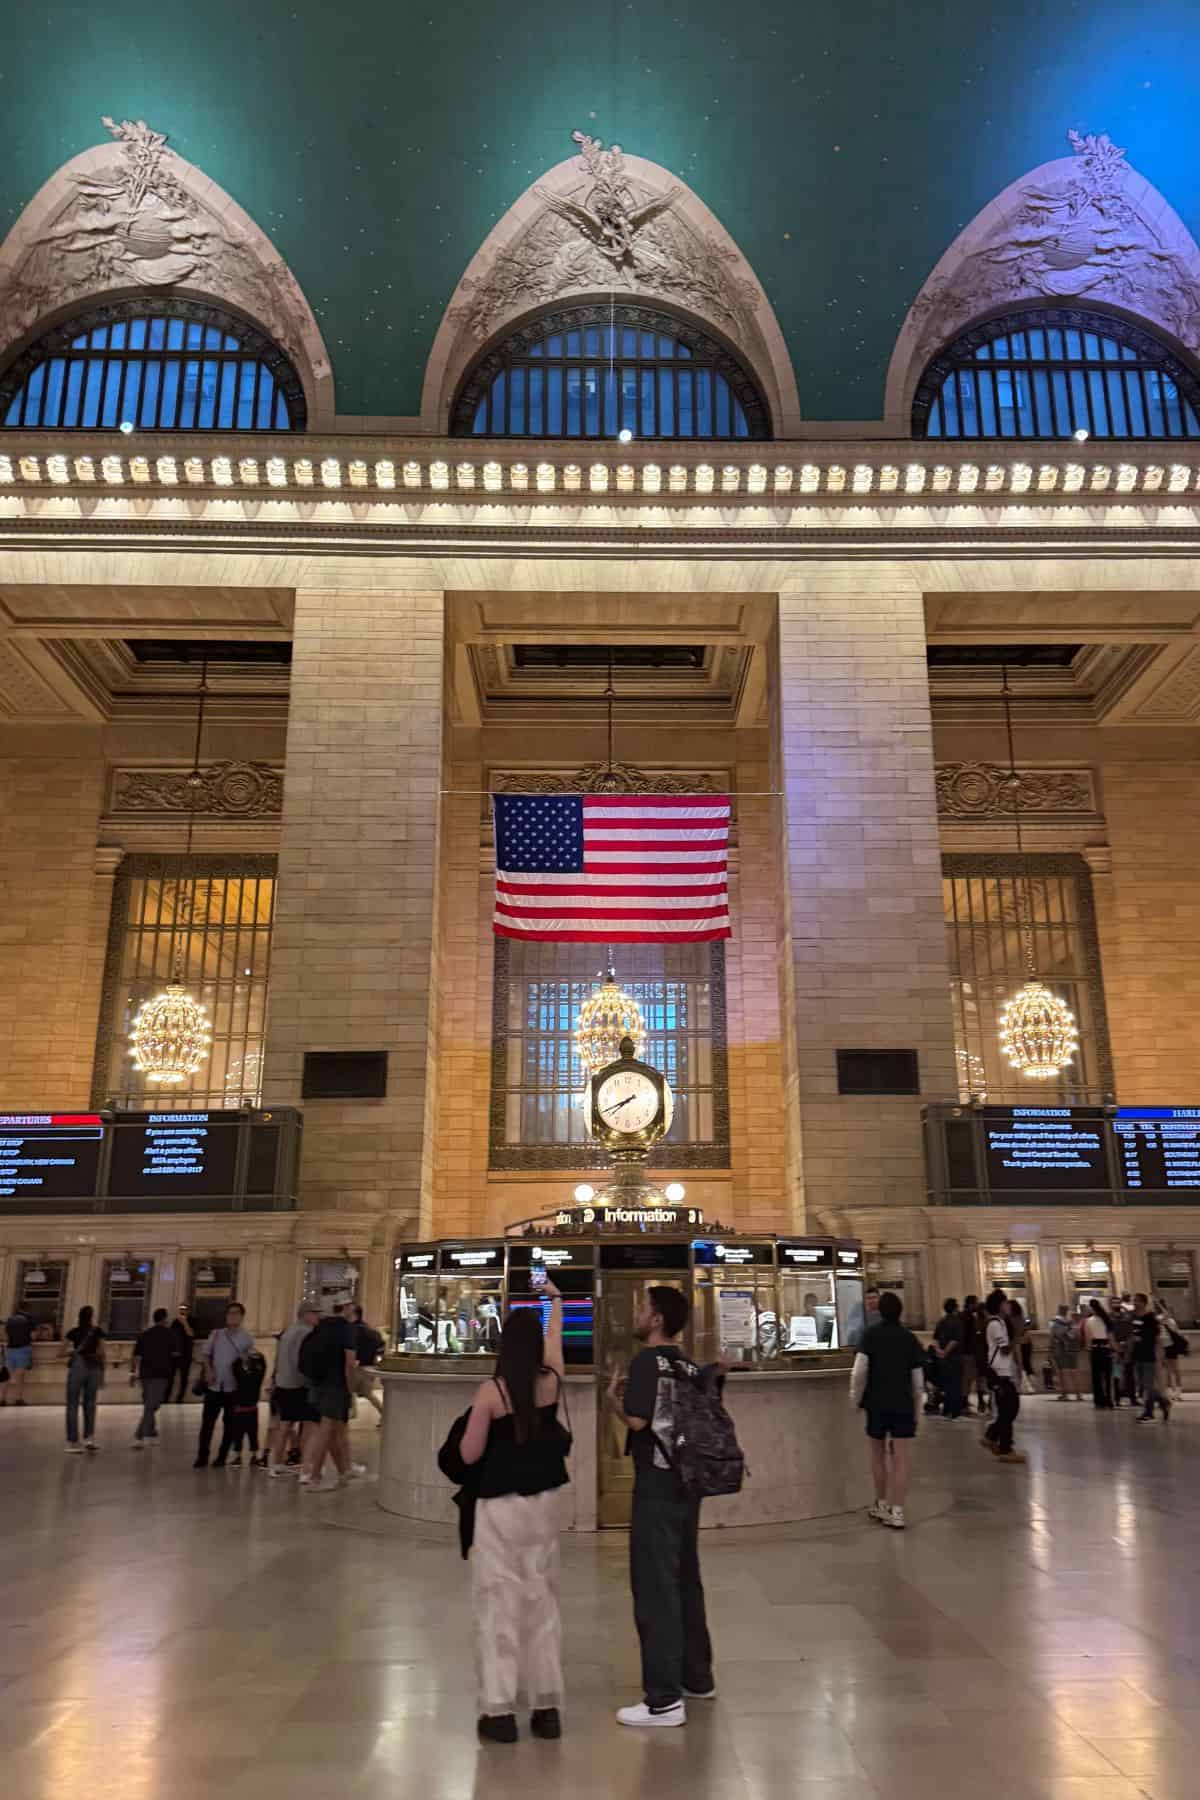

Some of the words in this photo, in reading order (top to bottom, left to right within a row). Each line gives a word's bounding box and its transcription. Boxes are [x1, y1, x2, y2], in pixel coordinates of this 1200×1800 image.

[1012, 1109, 1072, 1117] INFORMATION
[149, 1114, 208, 1122] INFORMATION
[604, 1208, 677, 1223] Information
